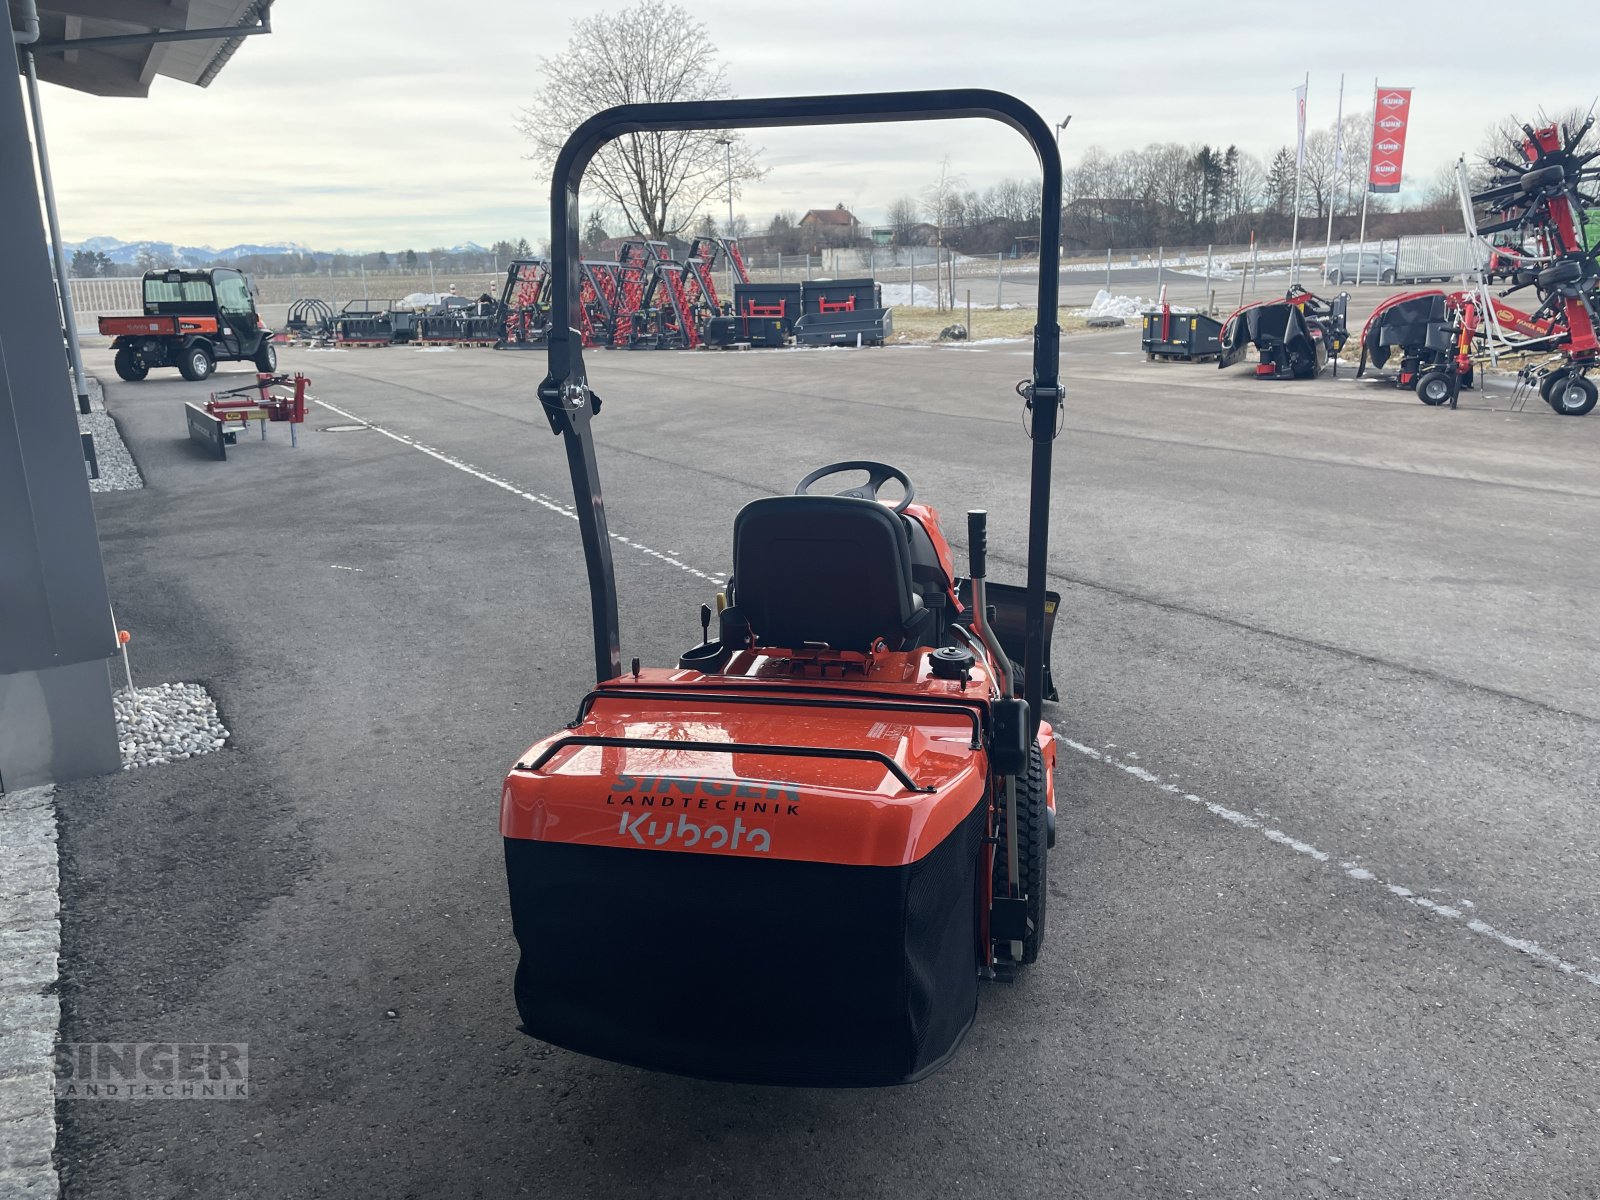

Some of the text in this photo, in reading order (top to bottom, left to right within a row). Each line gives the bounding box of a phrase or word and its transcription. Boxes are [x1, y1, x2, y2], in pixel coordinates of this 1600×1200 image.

[611, 775, 800, 801] SINGER
[606, 794, 799, 815] LANDTECHNIK
[618, 811, 771, 852] Kubota
